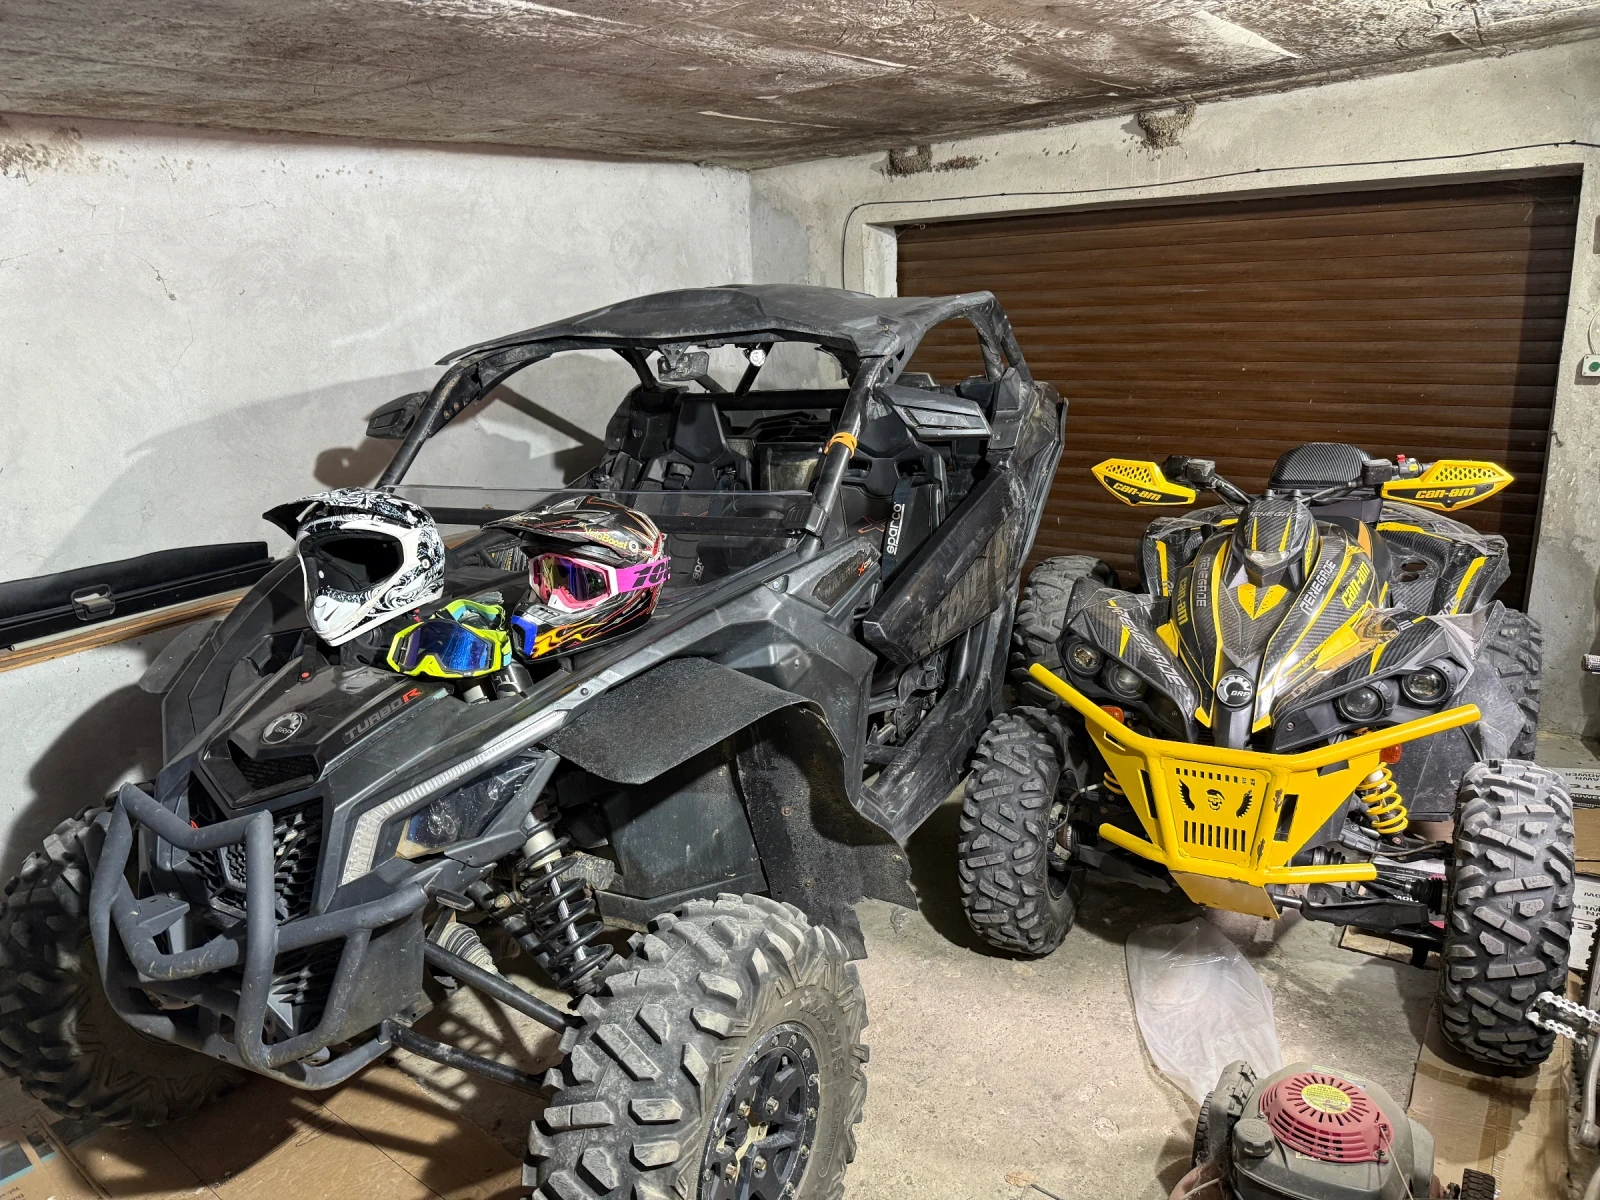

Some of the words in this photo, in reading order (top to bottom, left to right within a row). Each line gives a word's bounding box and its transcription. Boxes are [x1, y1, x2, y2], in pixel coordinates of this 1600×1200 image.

[1113, 482, 1162, 501] can-am
[1415, 487, 1476, 499] can-am
[886, 501, 904, 555] sparco
[1177, 576, 1189, 625] can-am
[1299, 559, 1336, 616] RENEGADE
[1341, 561, 1370, 609] can-am
[344, 698, 403, 740] TURBO
